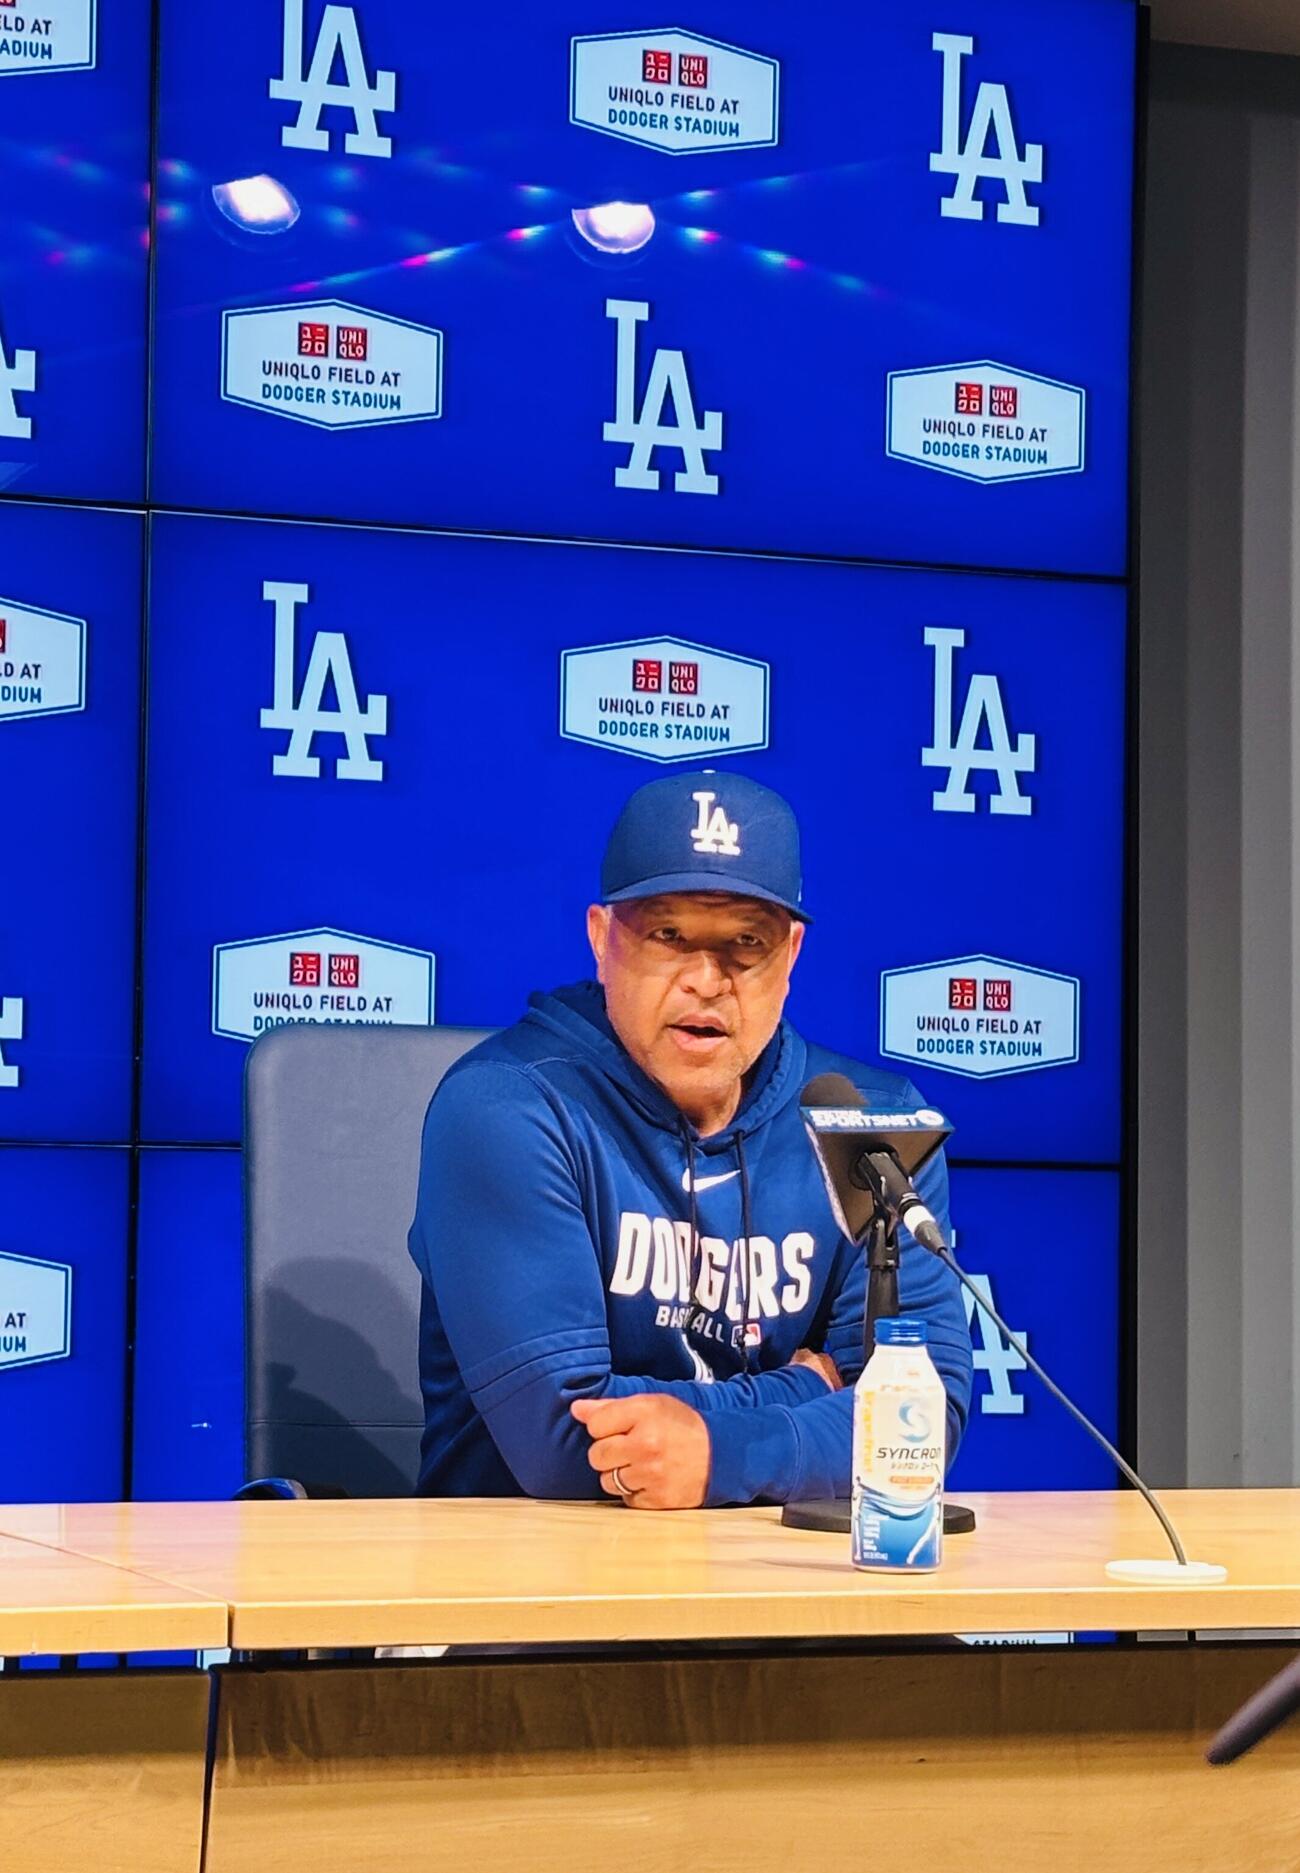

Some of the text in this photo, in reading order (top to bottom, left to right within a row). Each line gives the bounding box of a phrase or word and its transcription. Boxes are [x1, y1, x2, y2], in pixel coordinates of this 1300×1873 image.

[31, 18, 52, 36] AT
[270, 0, 395, 158] LA
[608, 86, 740, 115] UNIQLO FIELD AT
[608, 108, 740, 137] DODGER STADIUM
[929, 32, 1043, 226] LA
[262, 360, 401, 387] UNIQLO FIELD AT
[262, 383, 401, 411] DODGER STADIUM
[603, 298, 722, 495] LA
[922, 418, 1047, 443] UNIQLO FIELD AT
[922, 440, 1048, 465] DODGER STADIUM
[20, 663, 41, 680] AT
[260, 581, 387, 781] LA
[599, 697, 730, 720] UNIQLO FIELD AT
[921, 626, 1035, 816] LA
[599, 720, 730, 743] DODGER STADIUM
[690, 792, 741, 856] LA
[253, 992, 393, 1013] UNIQLO FIELD AT
[917, 1015, 1042, 1035] UNIQLO FIELD AT
[917, 1038, 1042, 1057] DODGER STADIUM
[5, 1312, 26, 1328] AT
